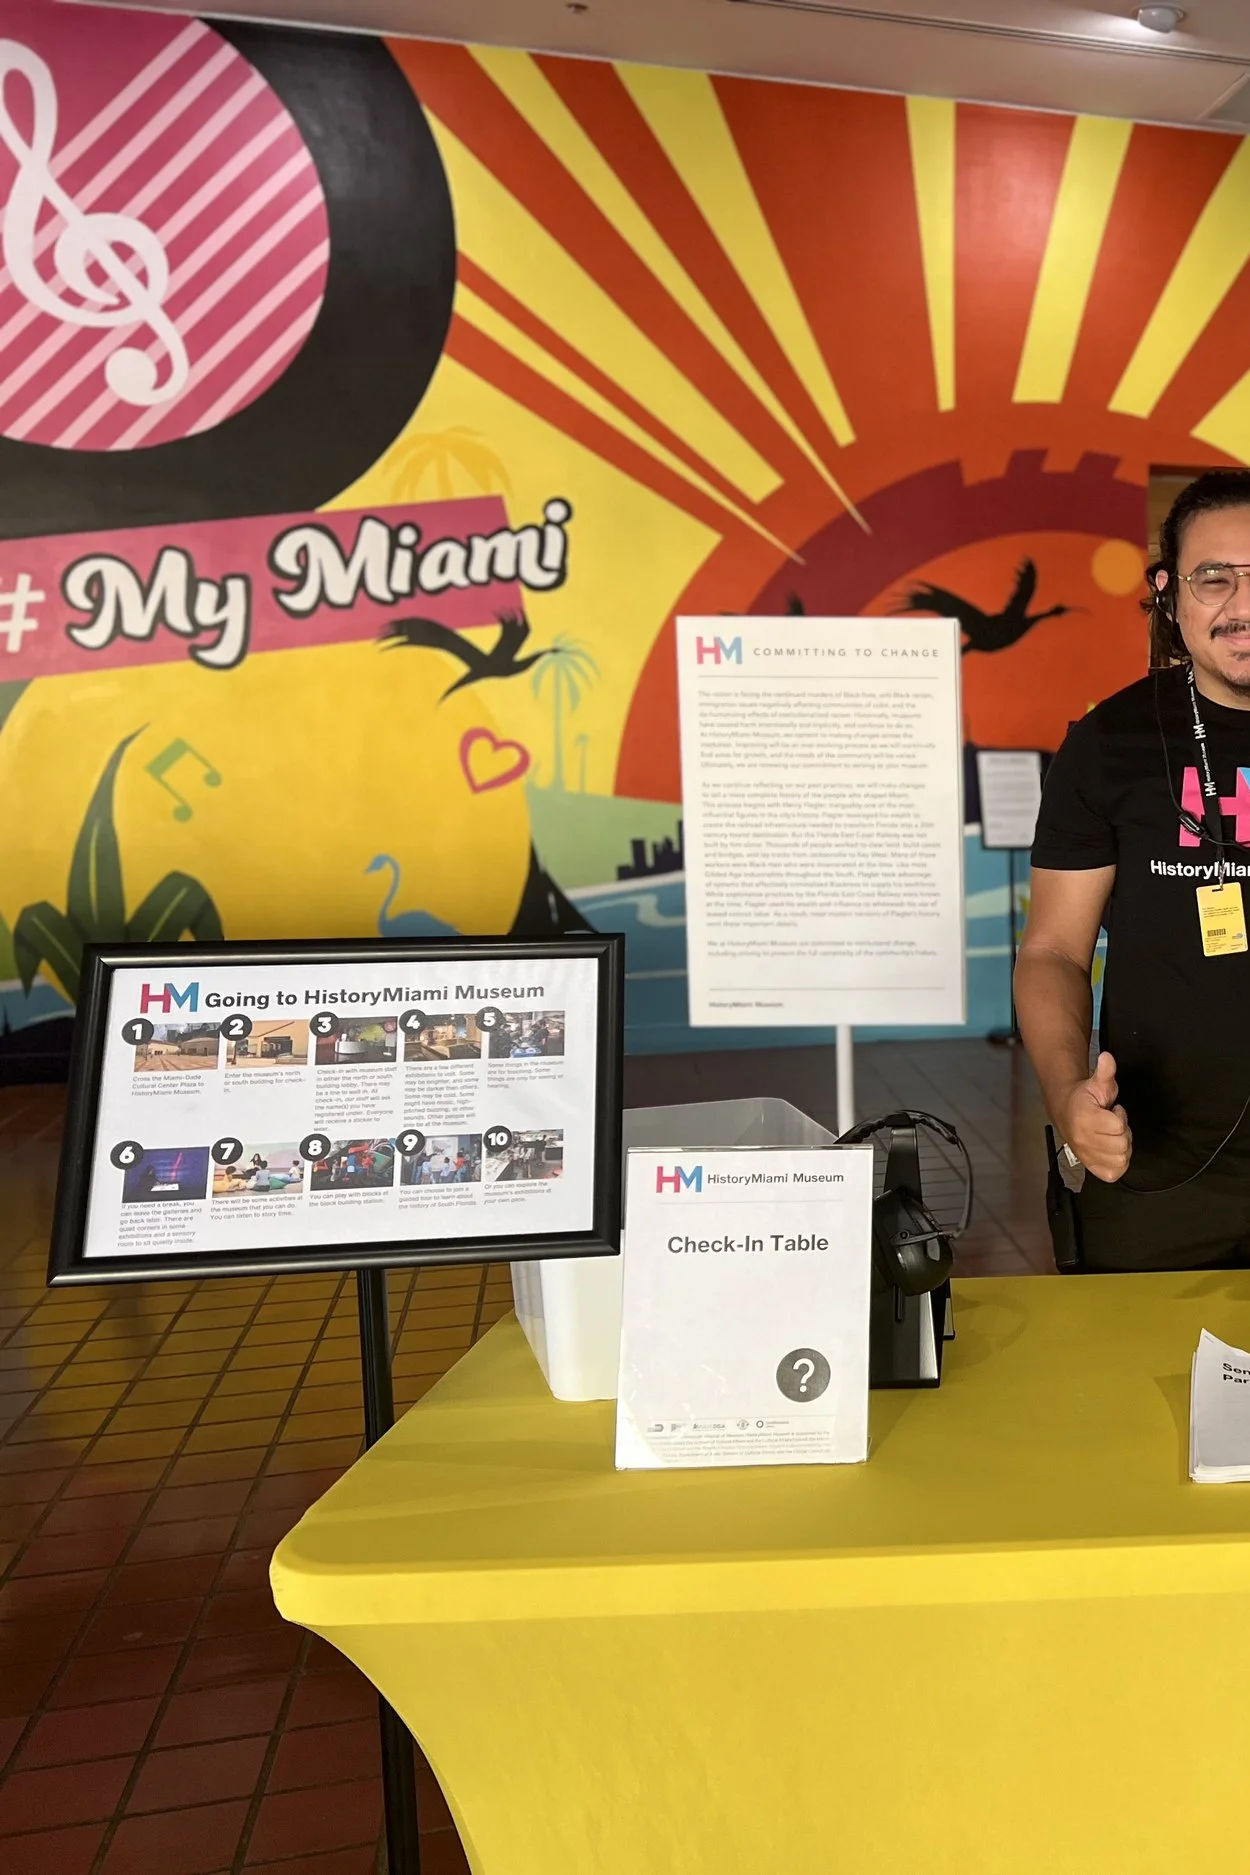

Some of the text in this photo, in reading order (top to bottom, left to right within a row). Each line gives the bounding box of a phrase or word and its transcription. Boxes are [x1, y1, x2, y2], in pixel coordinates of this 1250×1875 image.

[62, 547, 251, 669] My
[268, 497, 573, 618] Miami
[696, 636, 940, 665] HM COMMITTING TO CHANGE
[140, 981, 545, 1014] HM Going to HistoryMiami Museum
[227, 1018, 244, 1036] 2
[317, 1016, 332, 1034] 3
[406, 1014, 421, 1031] 4
[483, 1010, 496, 1027] 5
[132, 1023, 143, 1040] 1
[403, 1133, 418, 1151] 9
[488, 1130, 508, 1146] 10
[119, 1146, 134, 1164] 6
[221, 1142, 235, 1159] 7
[308, 1139, 322, 1156] 8
[656, 1165, 844, 1193] HM HistoryMiami Museum
[667, 1234, 829, 1253] Check-In Table
